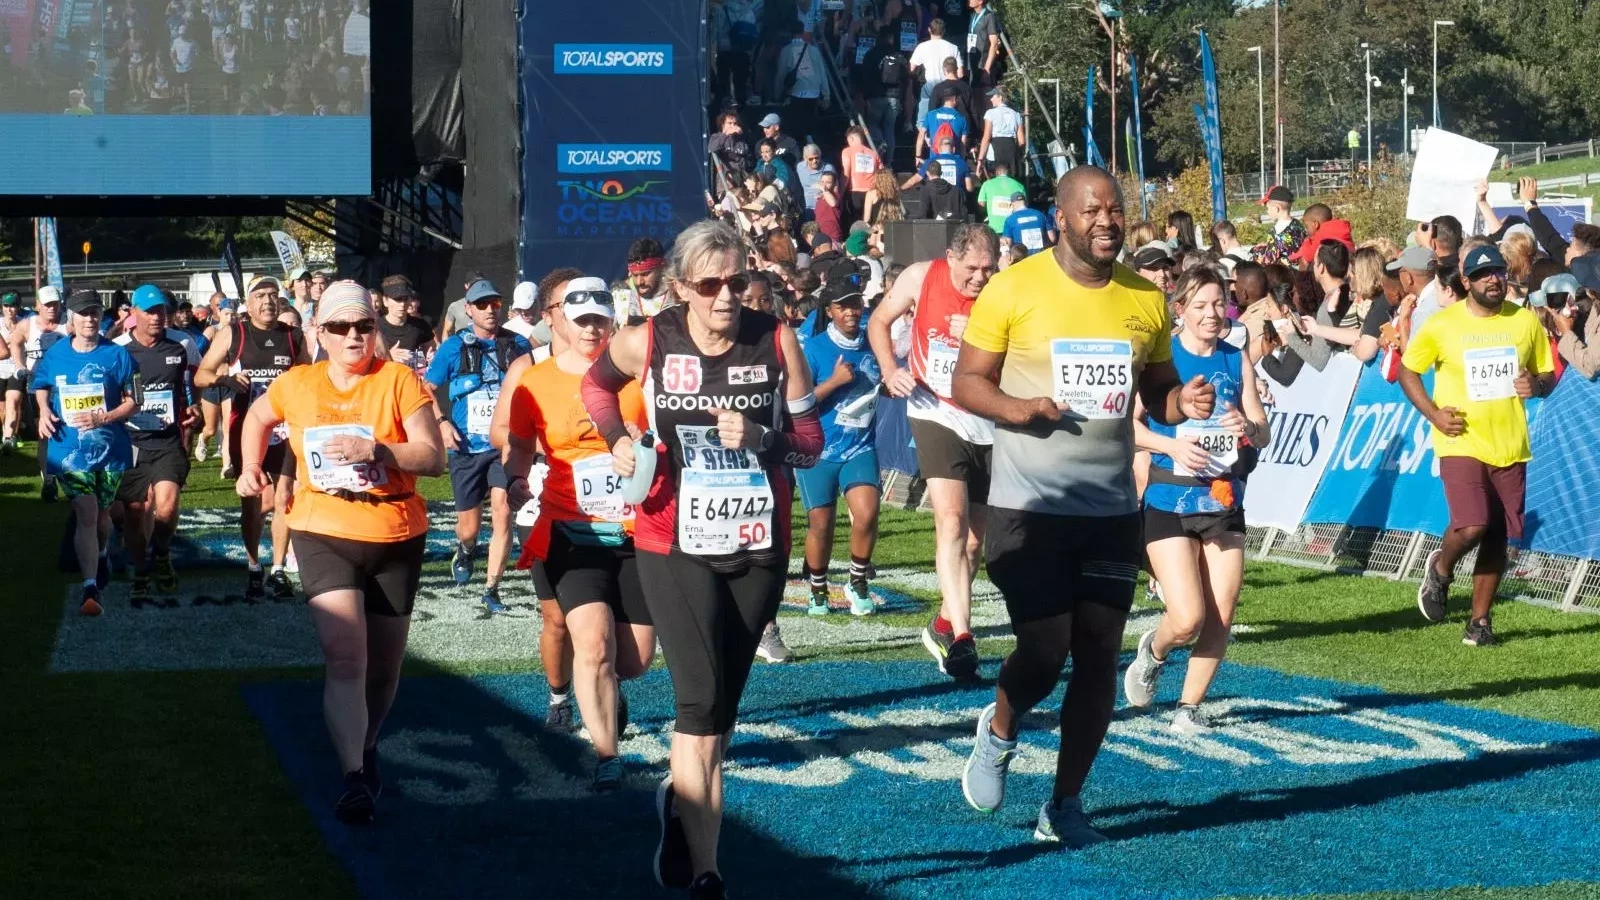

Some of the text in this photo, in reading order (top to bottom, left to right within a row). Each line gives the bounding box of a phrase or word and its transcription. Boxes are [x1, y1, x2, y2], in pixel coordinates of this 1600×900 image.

[562, 51, 664, 67] TOTALSPORTS
[567, 150, 662, 166] TOTALSPORTS
[556, 180, 624, 201] TWO
[556, 203, 673, 223] OCEANS
[557, 226, 674, 236] MARATHON
[666, 357, 699, 392] 55
[933, 359, 939, 373] E
[1061, 364, 1127, 386] E 73255
[1471, 362, 1514, 379] P 67641
[472, 404, 478, 416] K
[655, 392, 773, 410] GOODWOOD
[1059, 389, 1092, 398] Zwelethu
[1102, 391, 1127, 414] 40
[311, 451, 322, 469] D
[684, 446, 696, 468] P
[353, 465, 381, 487] 50
[582, 478, 592, 496] D
[690, 496, 769, 521] E 64747
[685, 525, 704, 533] Erna
[738, 522, 766, 548] 50
